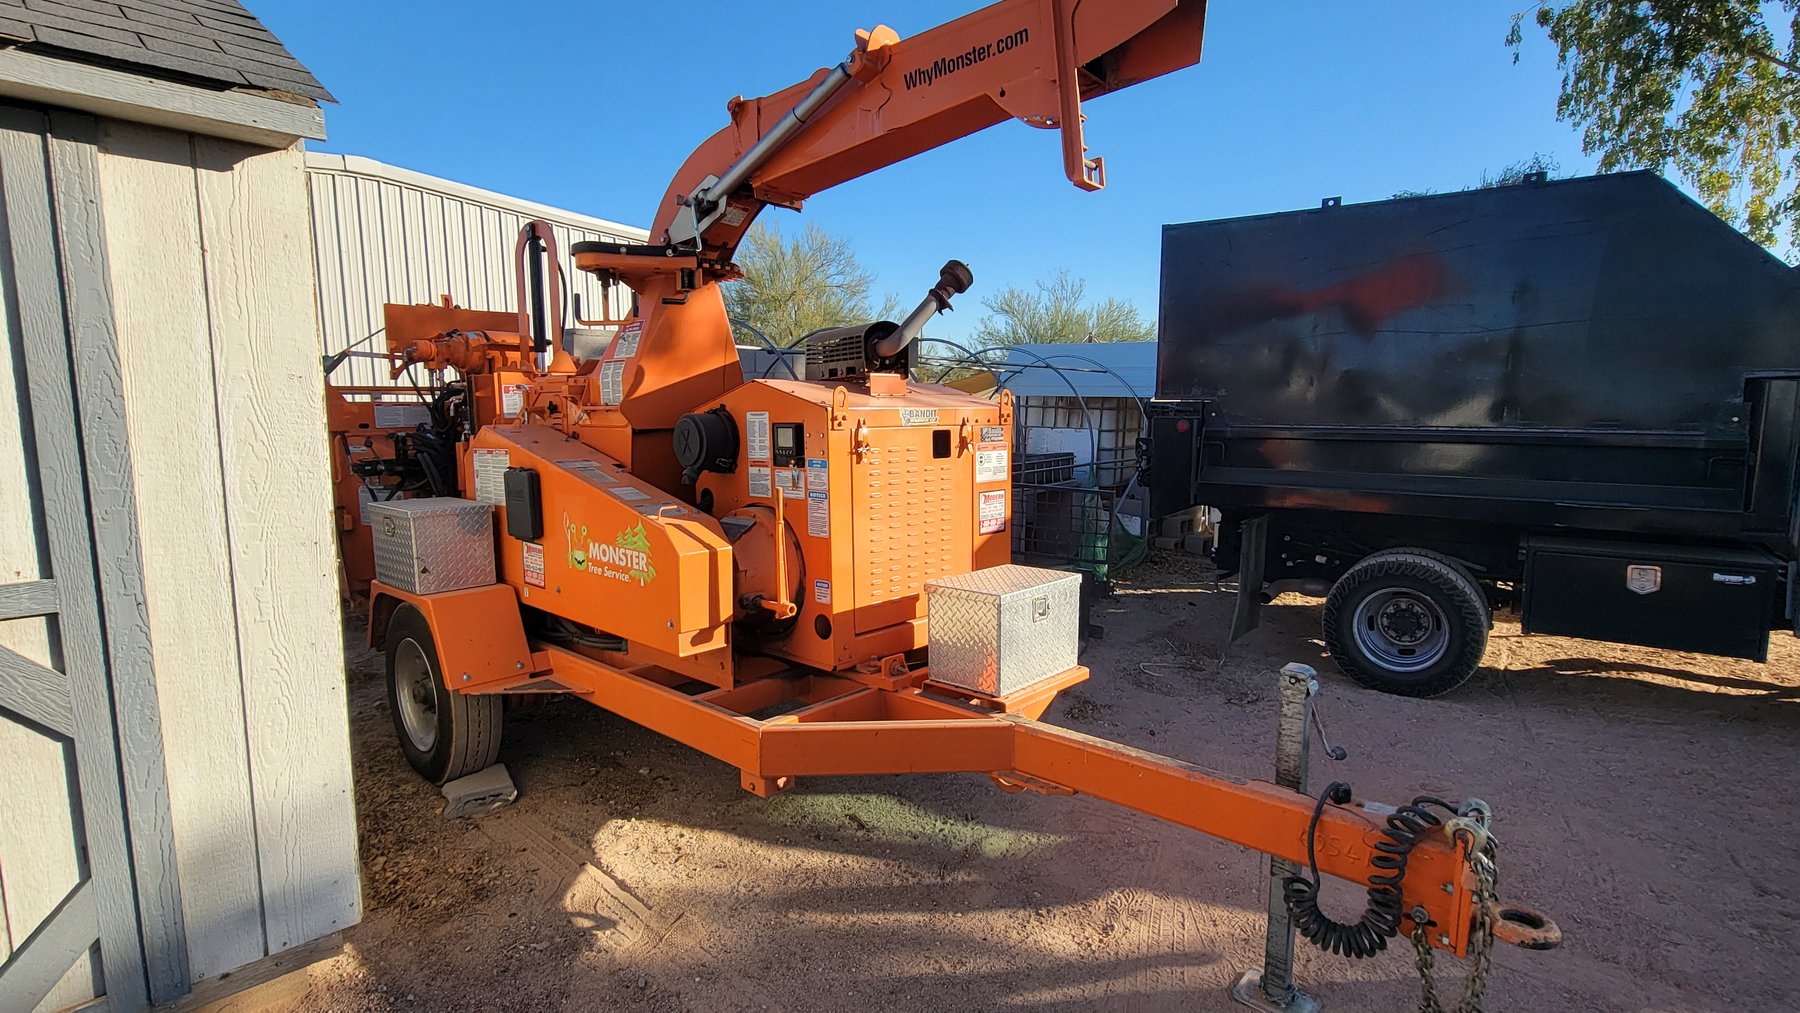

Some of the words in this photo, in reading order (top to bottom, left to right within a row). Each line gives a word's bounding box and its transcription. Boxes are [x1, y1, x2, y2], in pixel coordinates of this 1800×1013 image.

[904, 27, 1029, 91] WhyMonster.com
[909, 408, 938, 418] BANDIT
[589, 542, 648, 572] MONSTER
[588, 561, 603, 576] Tree
